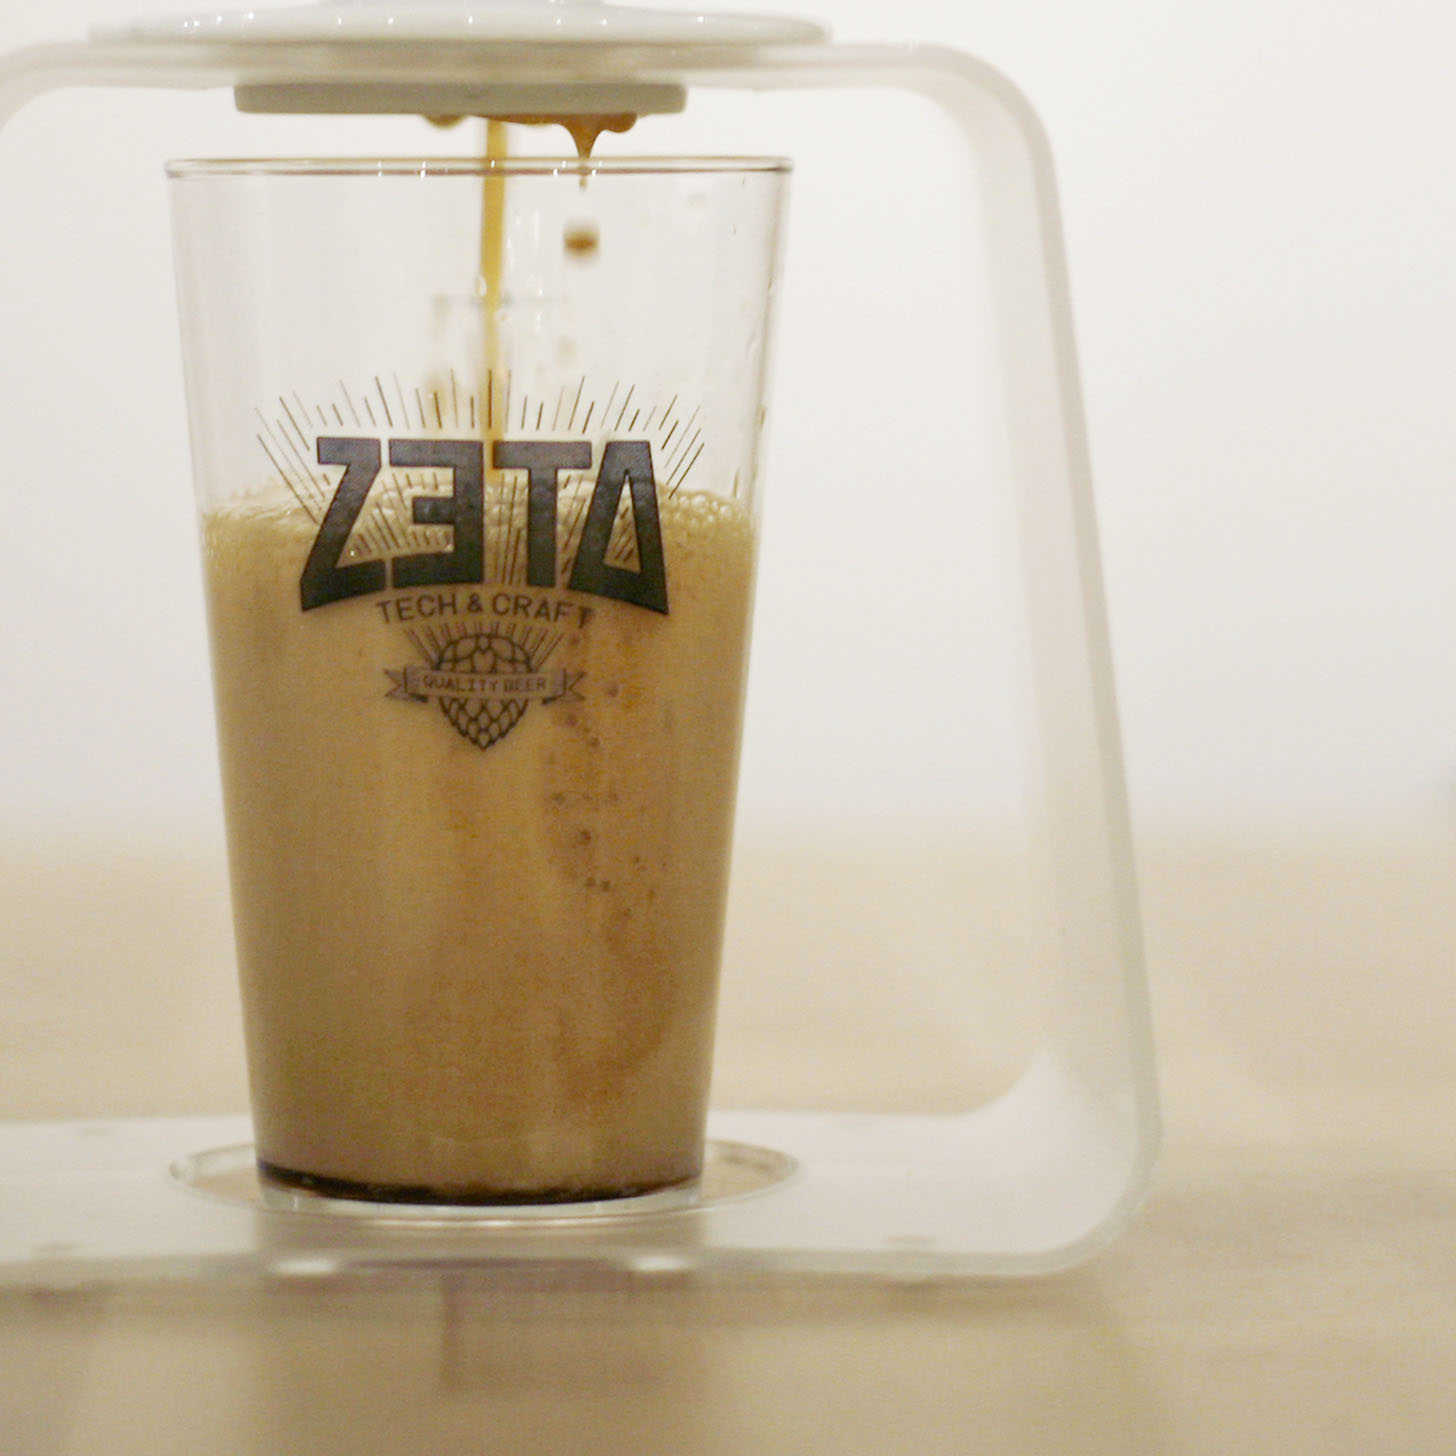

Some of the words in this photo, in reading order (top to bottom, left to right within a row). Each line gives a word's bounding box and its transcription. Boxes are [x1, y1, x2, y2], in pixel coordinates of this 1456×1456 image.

[376, 591, 458, 624] TECH
[467, 592, 483, 614] &
[492, 592, 596, 629] CRAFT
[422, 675, 499, 693] QUALITY
